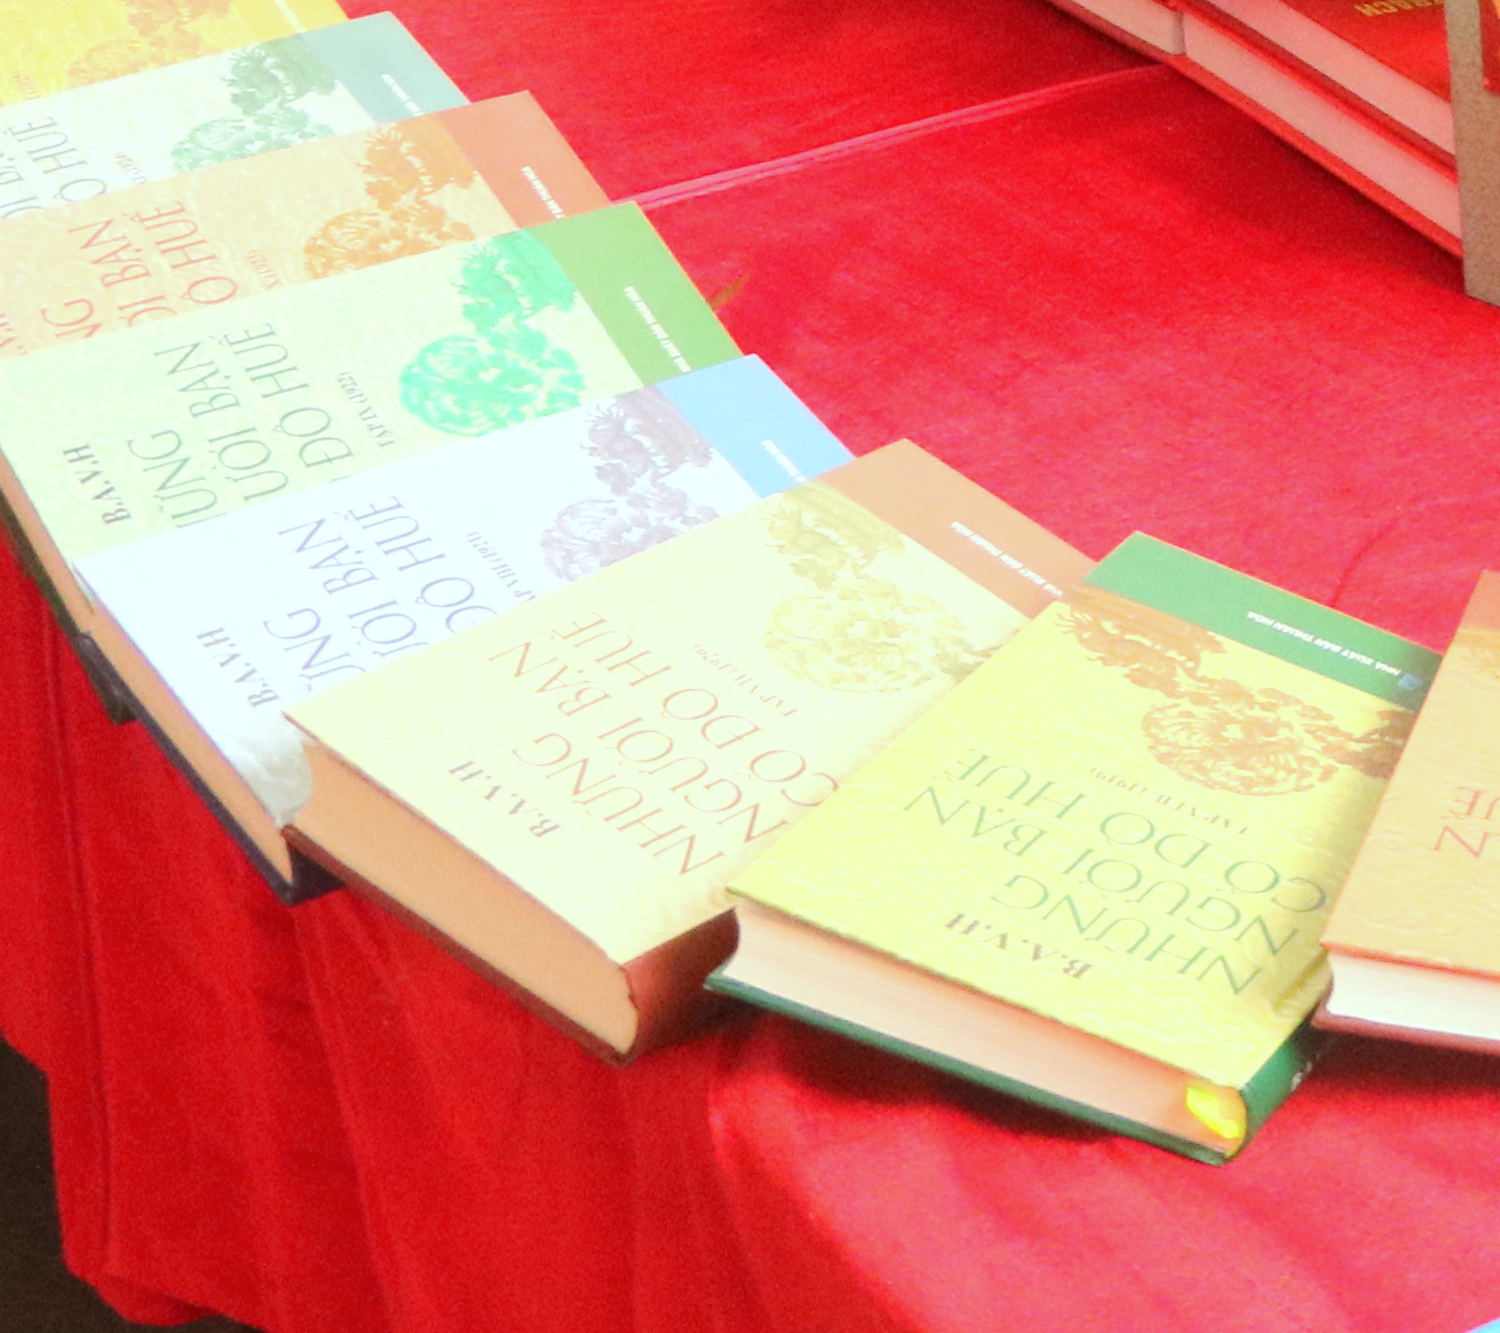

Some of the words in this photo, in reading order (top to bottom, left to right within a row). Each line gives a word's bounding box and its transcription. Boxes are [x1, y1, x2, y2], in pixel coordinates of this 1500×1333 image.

[62, 442, 131, 526] B.A.V.H
[488, 639, 612, 717] BẠN
[446, 759, 562, 839] B.A.V.H
[902, 784, 1048, 857] BẠN
[944, 910, 1094, 980] B.A.V.H
